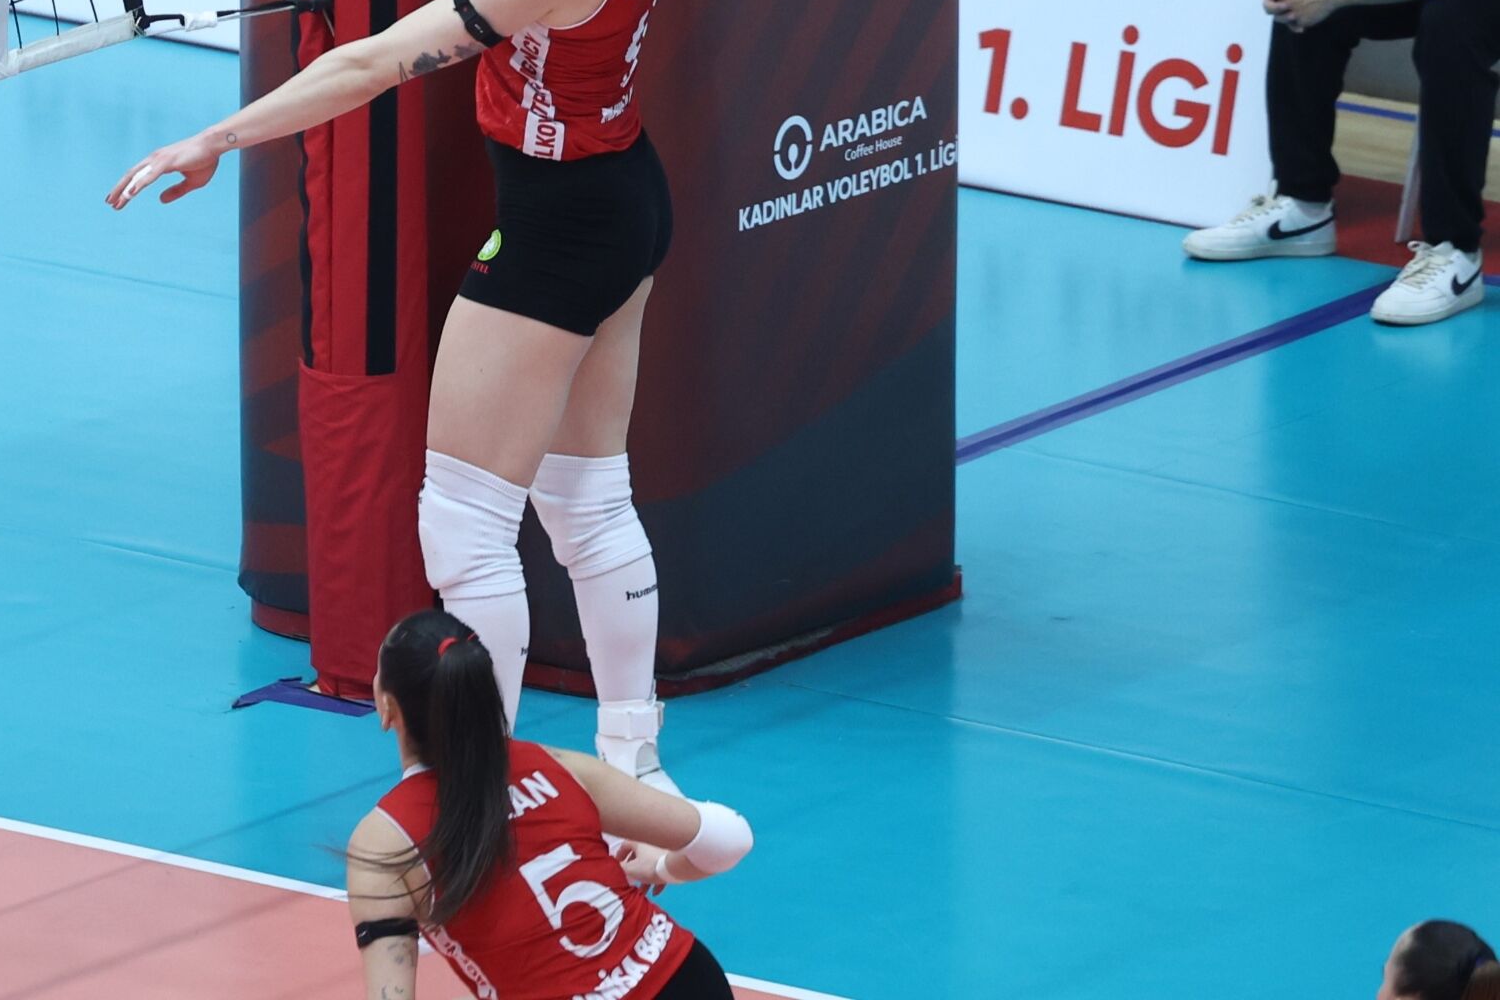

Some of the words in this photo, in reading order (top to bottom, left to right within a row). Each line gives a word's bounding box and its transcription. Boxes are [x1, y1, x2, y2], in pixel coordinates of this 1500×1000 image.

[819, 96, 928, 152] ARABICA
[978, 28, 1029, 121] 1.
[1059, 26, 1244, 156] LİGİ
[844, 143, 874, 162] Coffee
[875, 135, 903, 153] House
[738, 185, 824, 232] KADINLAR
[827, 160, 913, 204] VOLEYBOL
[915, 153, 927, 176] 1.
[517, 842, 626, 959] 5
